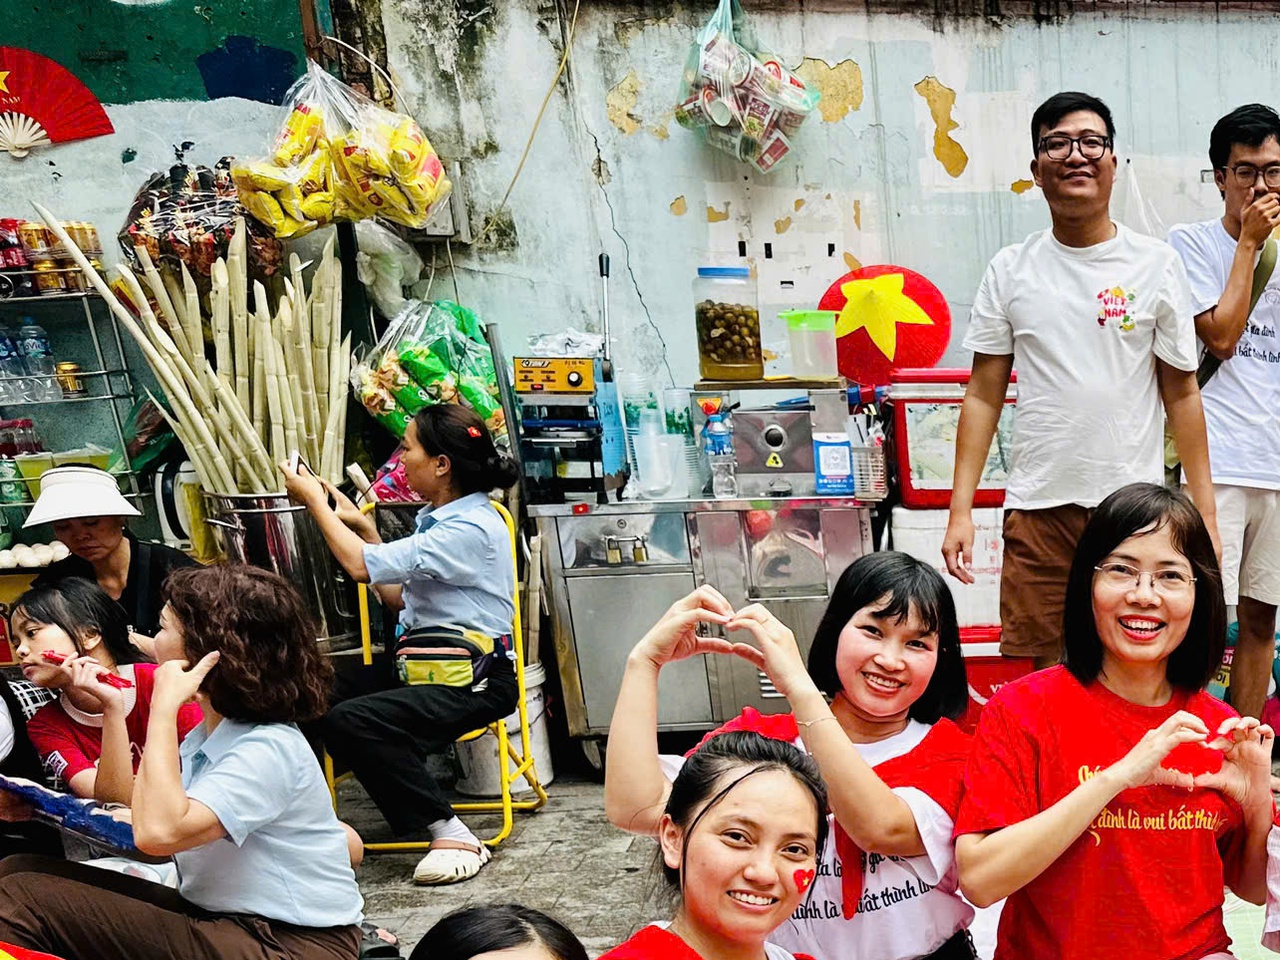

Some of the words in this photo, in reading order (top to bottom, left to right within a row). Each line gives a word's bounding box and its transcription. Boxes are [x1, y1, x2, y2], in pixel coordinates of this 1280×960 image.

[1098, 807, 1126, 829] đình
[1127, 808, 1143, 829] là
[1143, 813, 1167, 830] vui
[1168, 804, 1194, 830] bất
[824, 899, 841, 919] là
[880, 880, 918, 907] thình
